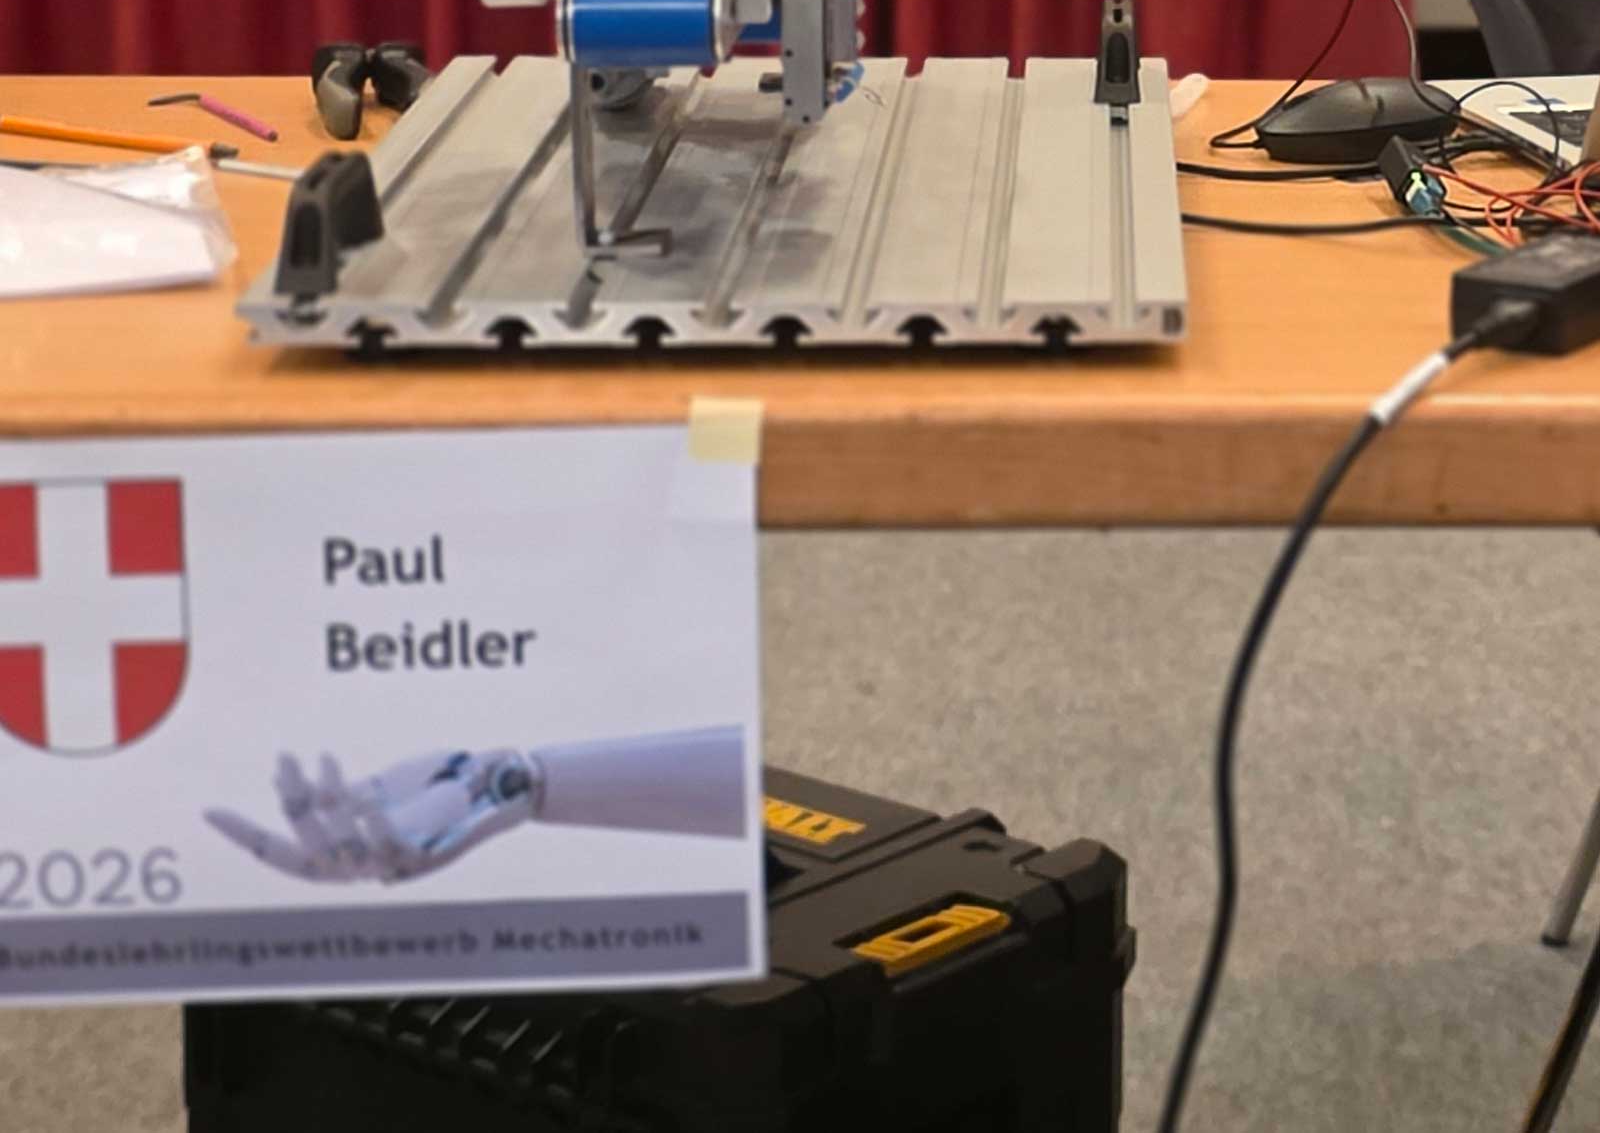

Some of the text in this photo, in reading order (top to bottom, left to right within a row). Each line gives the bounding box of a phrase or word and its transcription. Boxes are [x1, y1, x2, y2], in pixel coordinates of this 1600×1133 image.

[323, 533, 445, 586] Paul
[325, 618, 538, 673] Beidler
[0, 845, 183, 909] 2026
[493, 921, 704, 953] Mechatronik
